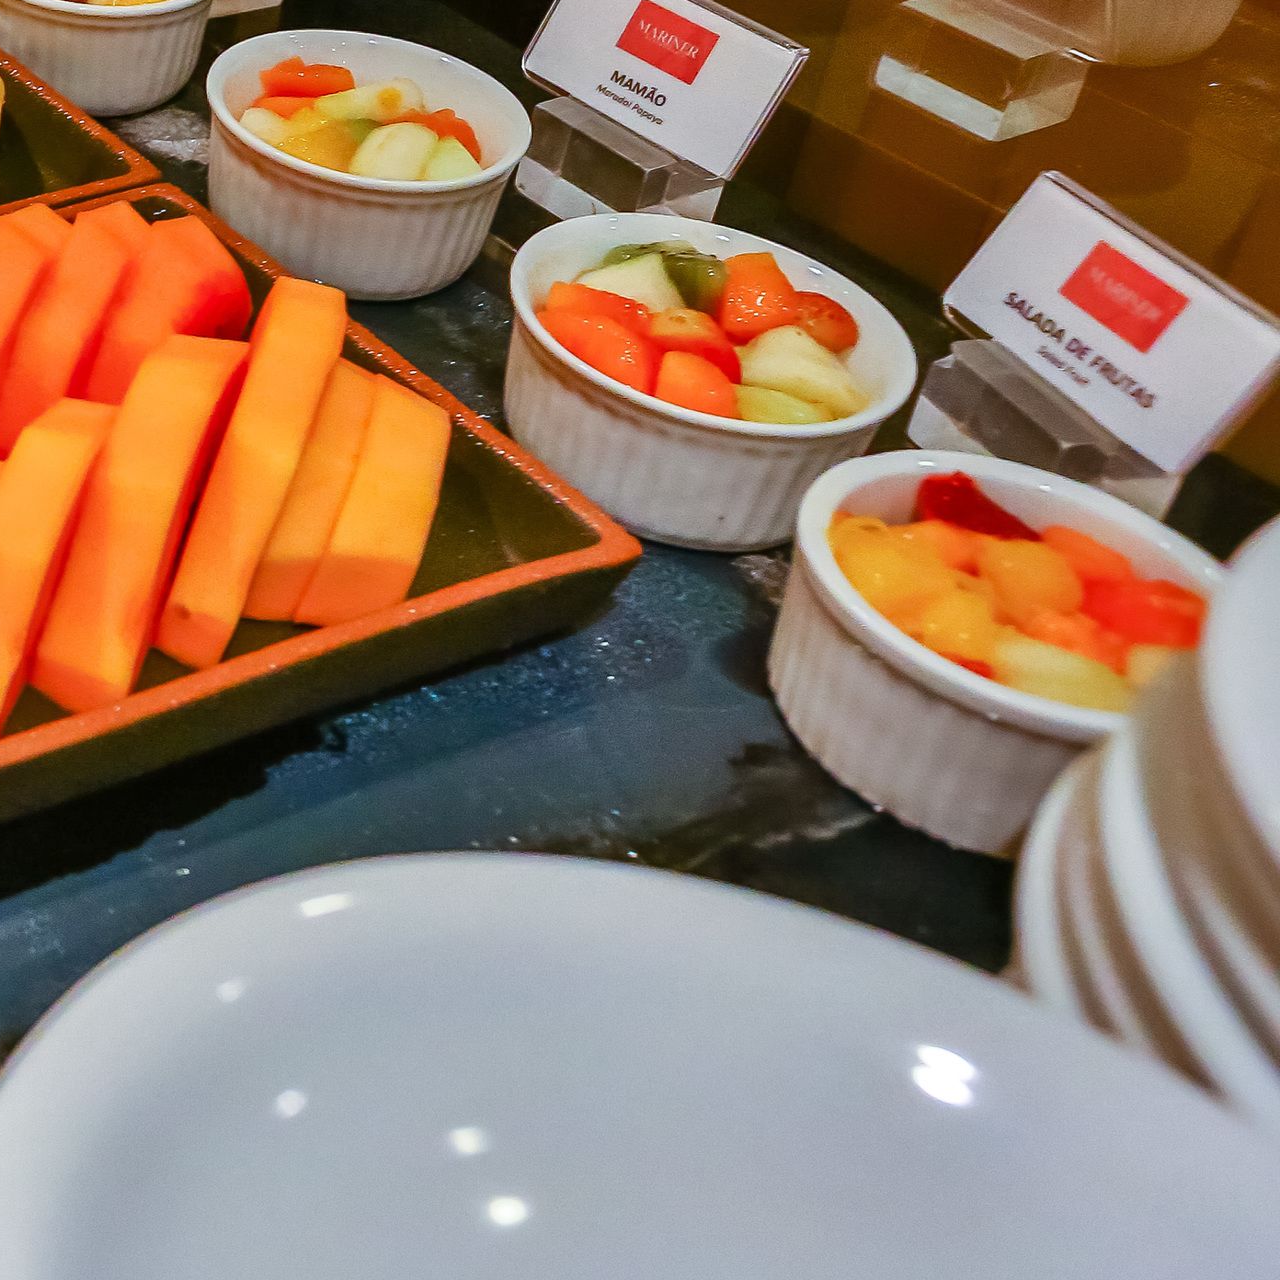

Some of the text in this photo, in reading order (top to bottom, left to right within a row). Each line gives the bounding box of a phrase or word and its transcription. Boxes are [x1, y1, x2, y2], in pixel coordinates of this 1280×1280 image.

[638, 19, 700, 59] MARINER
[610, 70, 667, 107] MAMÃO
[631, 102, 664, 125] Papaya
[1003, 291, 1156, 408] SALADA DE FRUTAS
